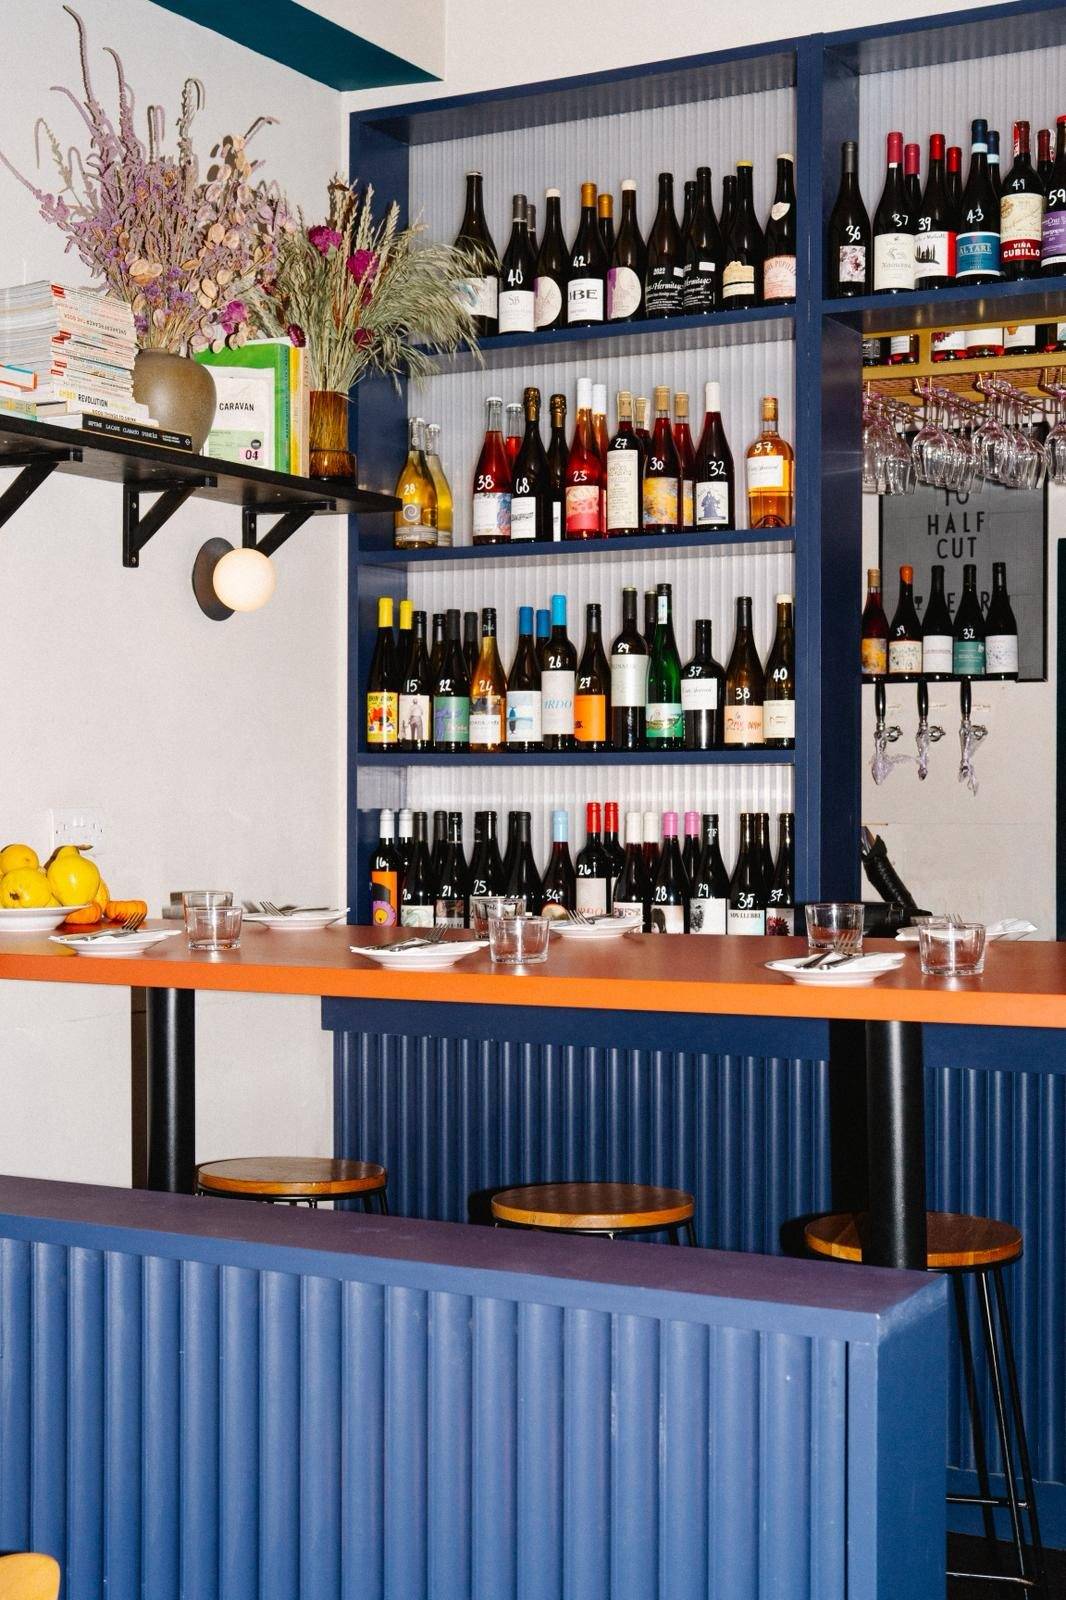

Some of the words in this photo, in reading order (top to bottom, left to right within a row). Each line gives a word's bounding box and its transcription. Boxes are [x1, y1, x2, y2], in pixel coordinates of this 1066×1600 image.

[1048, 188, 1066, 207] 59
[892, 213, 909, 227] 37
[966, 208, 984, 224] 43
[918, 216, 932, 232] 39
[845, 225, 861, 243] 36
[1013, 241, 1031, 249] VIÑA
[1003, 248, 1040, 258] CUBILLO
[572, 255, 587, 268] 42
[507, 268, 523, 287] 40
[78, 393, 108, 407] REVOLUTION
[219, 402, 255, 411] CARAVAN
[614, 438, 628, 449] 27
[245, 449, 259, 460] 04
[650, 457, 664, 471] 30
[708, 460, 727, 477] 32
[476, 474, 495, 491] 38
[573, 470, 588, 482] 23
[403, 483, 416, 496] 28
[515, 477, 530, 494] 68
[927, 511, 985, 536] HALF
[937, 536, 977, 559] CUT
[962, 627, 976, 640] 32
[617, 642, 630, 653] 29
[548, 655, 562, 669] 26
[688, 666, 702, 678] 37
[773, 667, 788, 682] 40
[406, 679, 418, 693] 15
[439, 678, 452, 692] 22
[479, 680, 493, 694] 24
[578, 676, 591, 690] 27
[735, 687, 751, 700] 38
[375, 856, 387, 870] 16
[578, 864, 592, 876] 26
[441, 885, 452, 897] 21
[473, 879, 487, 895] 25
[655, 885, 668, 902] 28
[697, 882, 709, 898] 29
[402, 888, 412, 901] 20
[545, 888, 561, 903] 34
[737, 892, 755, 909] 35
[770, 888, 784, 902] 37
